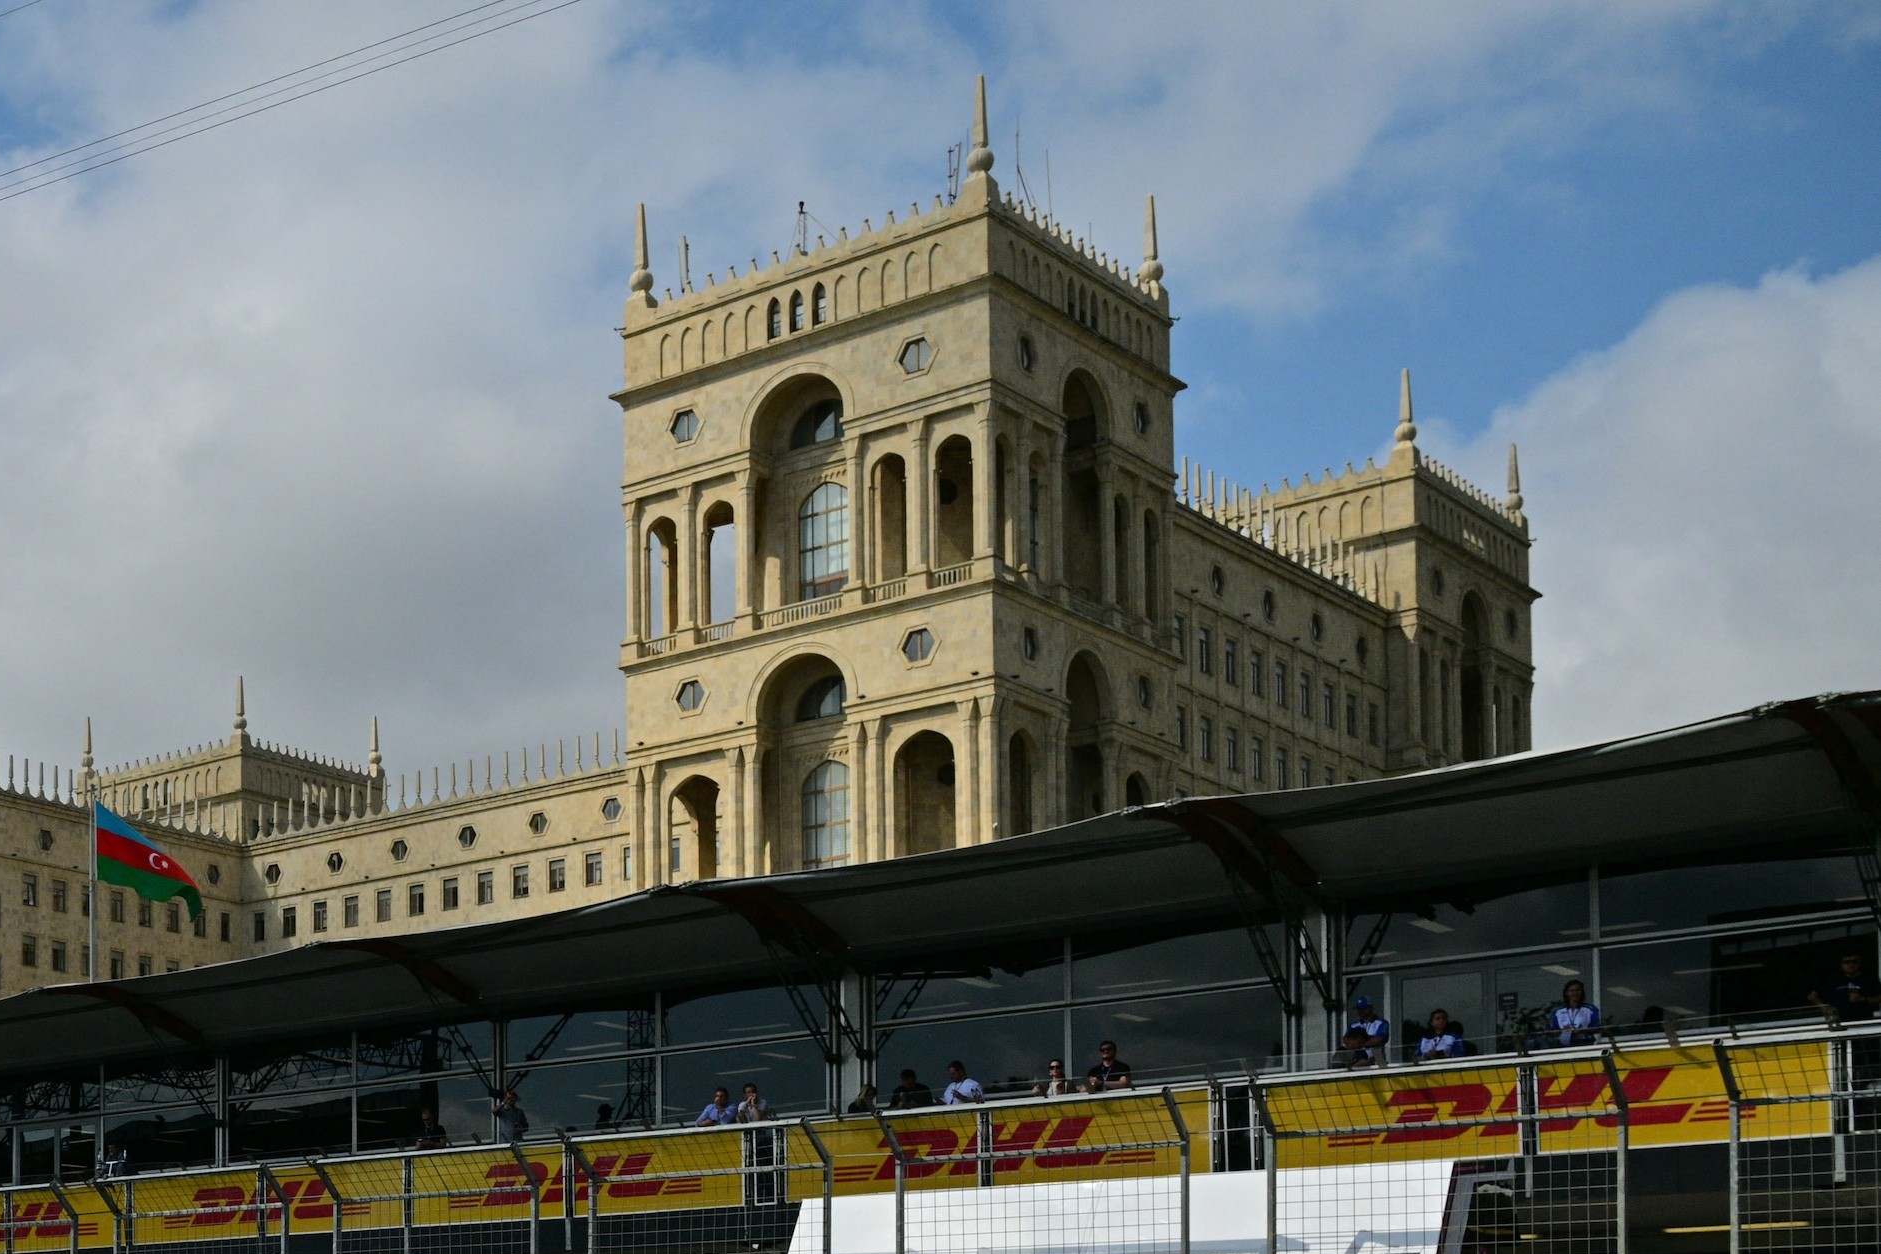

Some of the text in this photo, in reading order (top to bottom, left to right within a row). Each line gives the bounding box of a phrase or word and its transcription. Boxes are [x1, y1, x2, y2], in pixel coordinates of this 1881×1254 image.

[1381, 1067, 1692, 1144] DHL
[874, 1116, 1108, 1181] DHL
[190, 1177, 349, 1227] DHL
[471, 1153, 668, 1206] DHL
